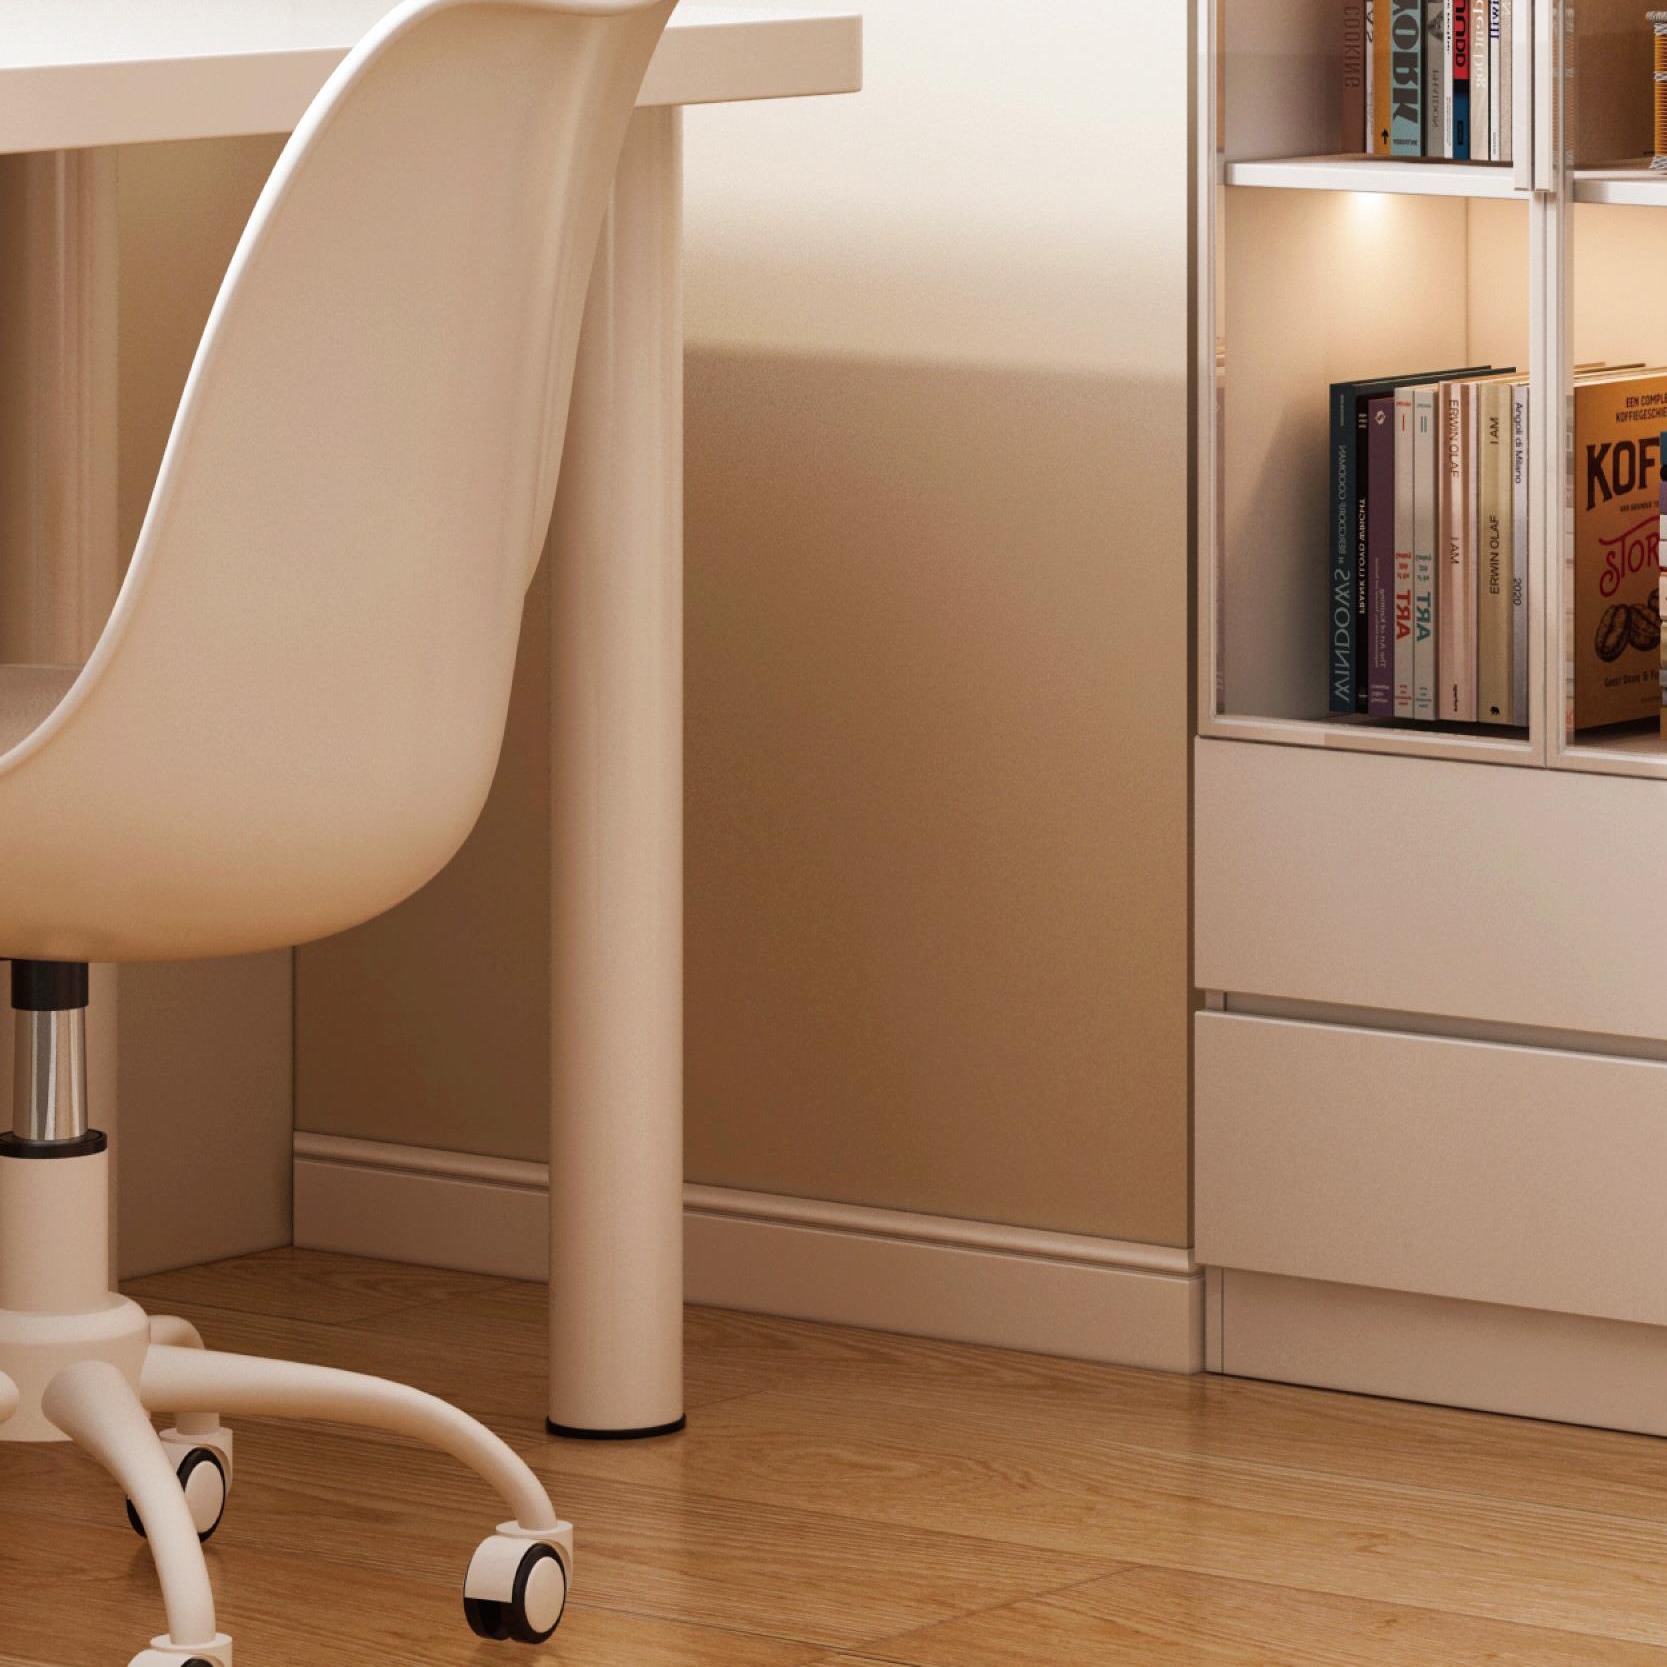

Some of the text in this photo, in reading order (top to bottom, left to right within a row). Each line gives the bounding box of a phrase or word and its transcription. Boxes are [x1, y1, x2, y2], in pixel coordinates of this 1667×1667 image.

[1625, 396, 1639, 408] EEN
[1449, 399, 1459, 442] ERWIN
[1490, 417, 1499, 439] AM
[1449, 444, 1459, 478] OLAF
[1513, 402, 1523, 606] Angoli di Milano 2020
[1489, 515, 1499, 549] OLAF
[1450, 542, 1459, 564] AM
[1490, 552, 1499, 595] ERWIN
